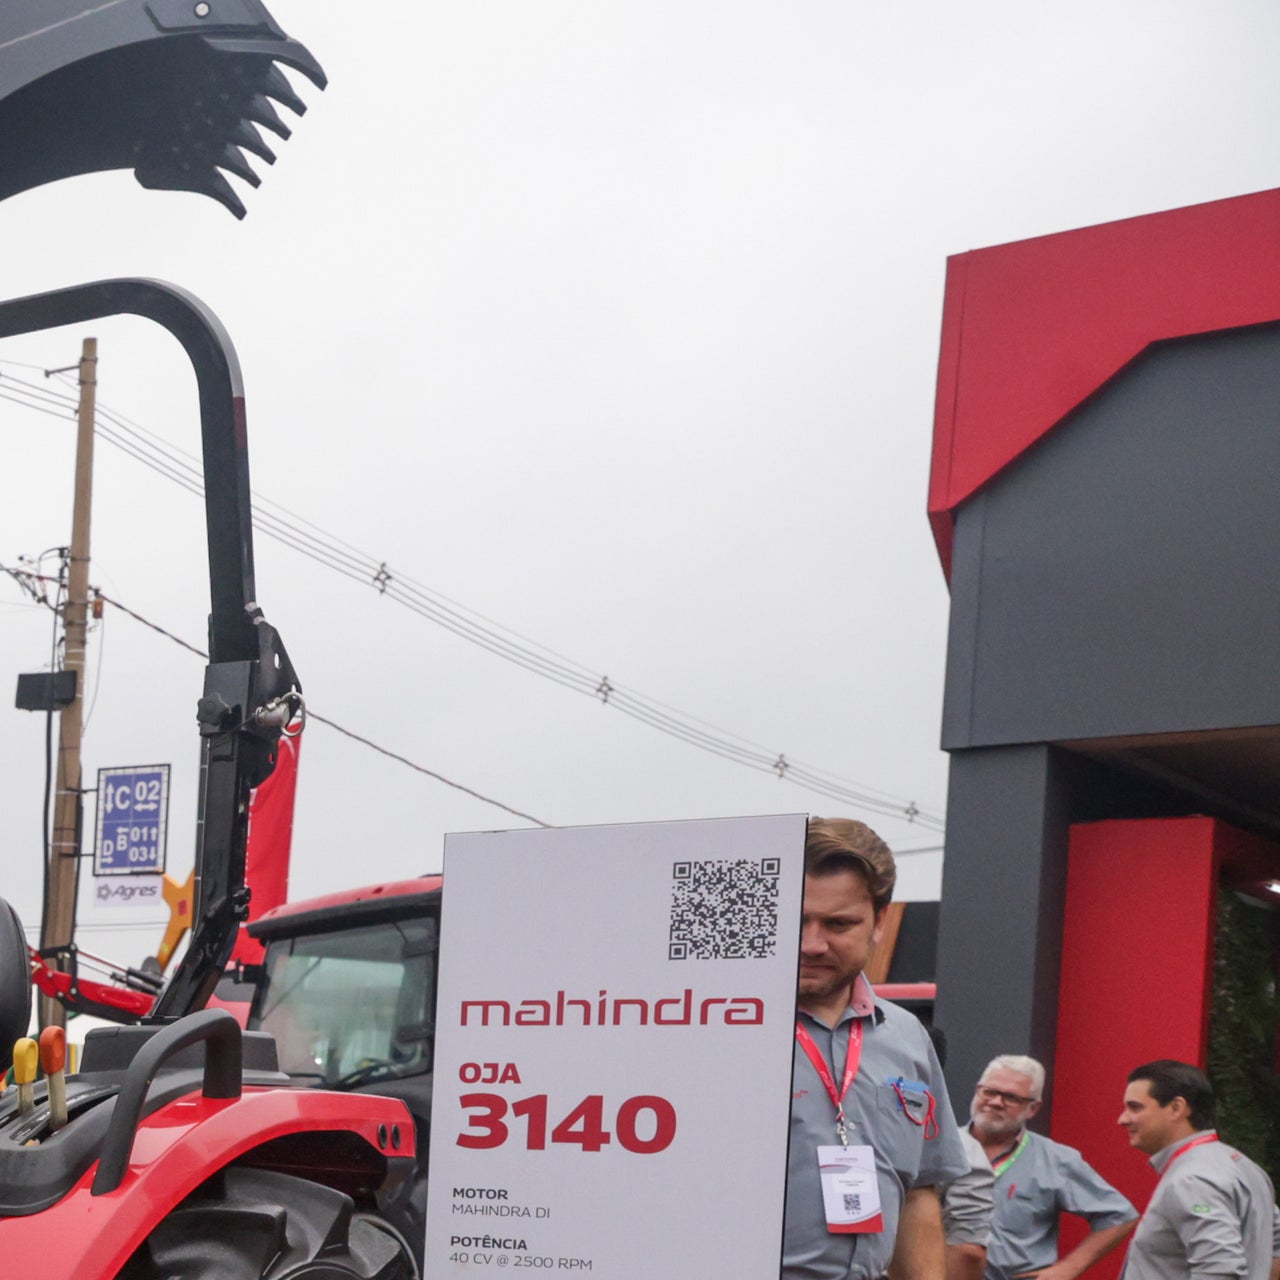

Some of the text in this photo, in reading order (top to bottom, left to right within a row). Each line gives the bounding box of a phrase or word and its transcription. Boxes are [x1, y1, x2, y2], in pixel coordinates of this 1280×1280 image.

[114, 785, 131, 810] C
[135, 780, 160, 801] 02
[116, 834, 127, 850] B
[130, 827, 148, 842] 01
[103, 840, 113, 856] D
[129, 847, 148, 862] 03
[111, 885, 158, 900] Agres
[460, 988, 765, 1026] mahindra
[459, 1062, 522, 1084] OJA
[455, 1093, 677, 1154] 3140
[453, 1187, 508, 1200] MOTOR
[452, 1203, 550, 1218] MAHINDRA DI
[450, 1235, 527, 1250] POTÊNCIA
[449, 1252, 593, 1270] 40 CV @ 2500 RPM
